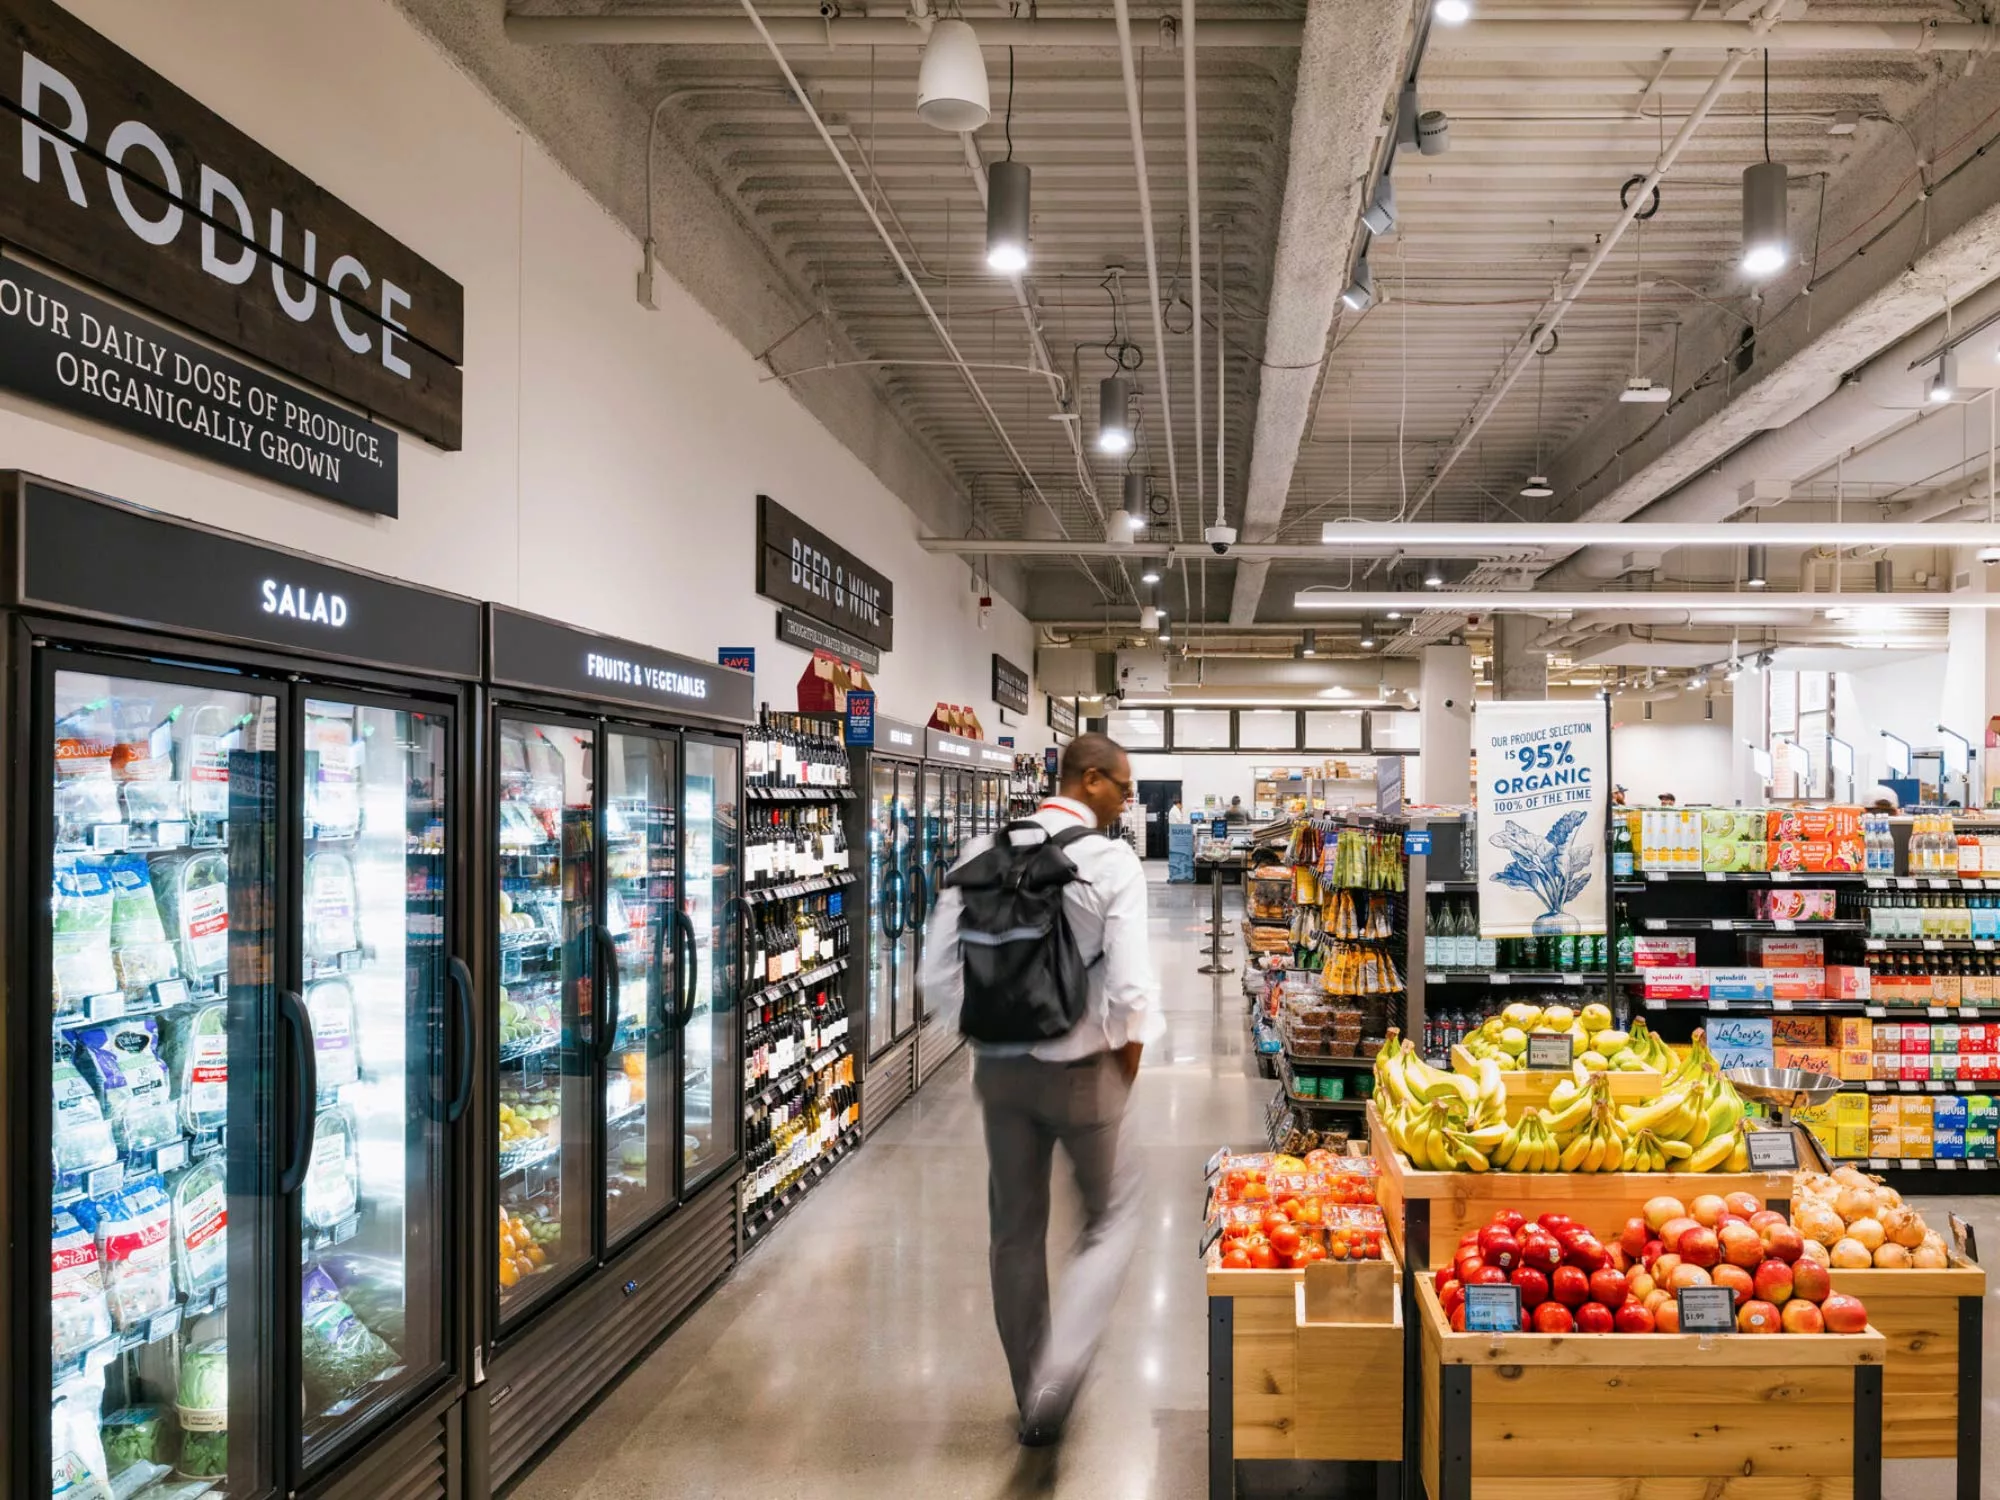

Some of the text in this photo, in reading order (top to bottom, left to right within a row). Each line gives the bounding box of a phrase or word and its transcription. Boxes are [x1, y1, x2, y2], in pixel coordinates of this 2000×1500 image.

[21, 50, 412, 379] RODUCE
[0, 278, 384, 468] OUR DAILY DOSE OF PRODUCE,
[56, 352, 340, 483] ORGANICALLY GROWN
[791, 537, 880, 627] BEER & WINE
[262, 579, 347, 627] SALAD
[723, 657, 750, 667] SAVE
[588, 653, 706, 699] FRUITS & VEGETABLES
[851, 706, 870, 716] 10%
[1491, 722, 1592, 747] OUR PRODUCE SELECTION
[1505, 740, 1574, 772] IS 95%
[1494, 767, 1592, 794] ORGANIC
[1494, 789, 1591, 812] 100% OF THE TIME
[1638, 941, 1669, 950] spindrift
[1768, 942, 1798, 951] spindrift
[1715, 974, 1747, 982] spindrift
